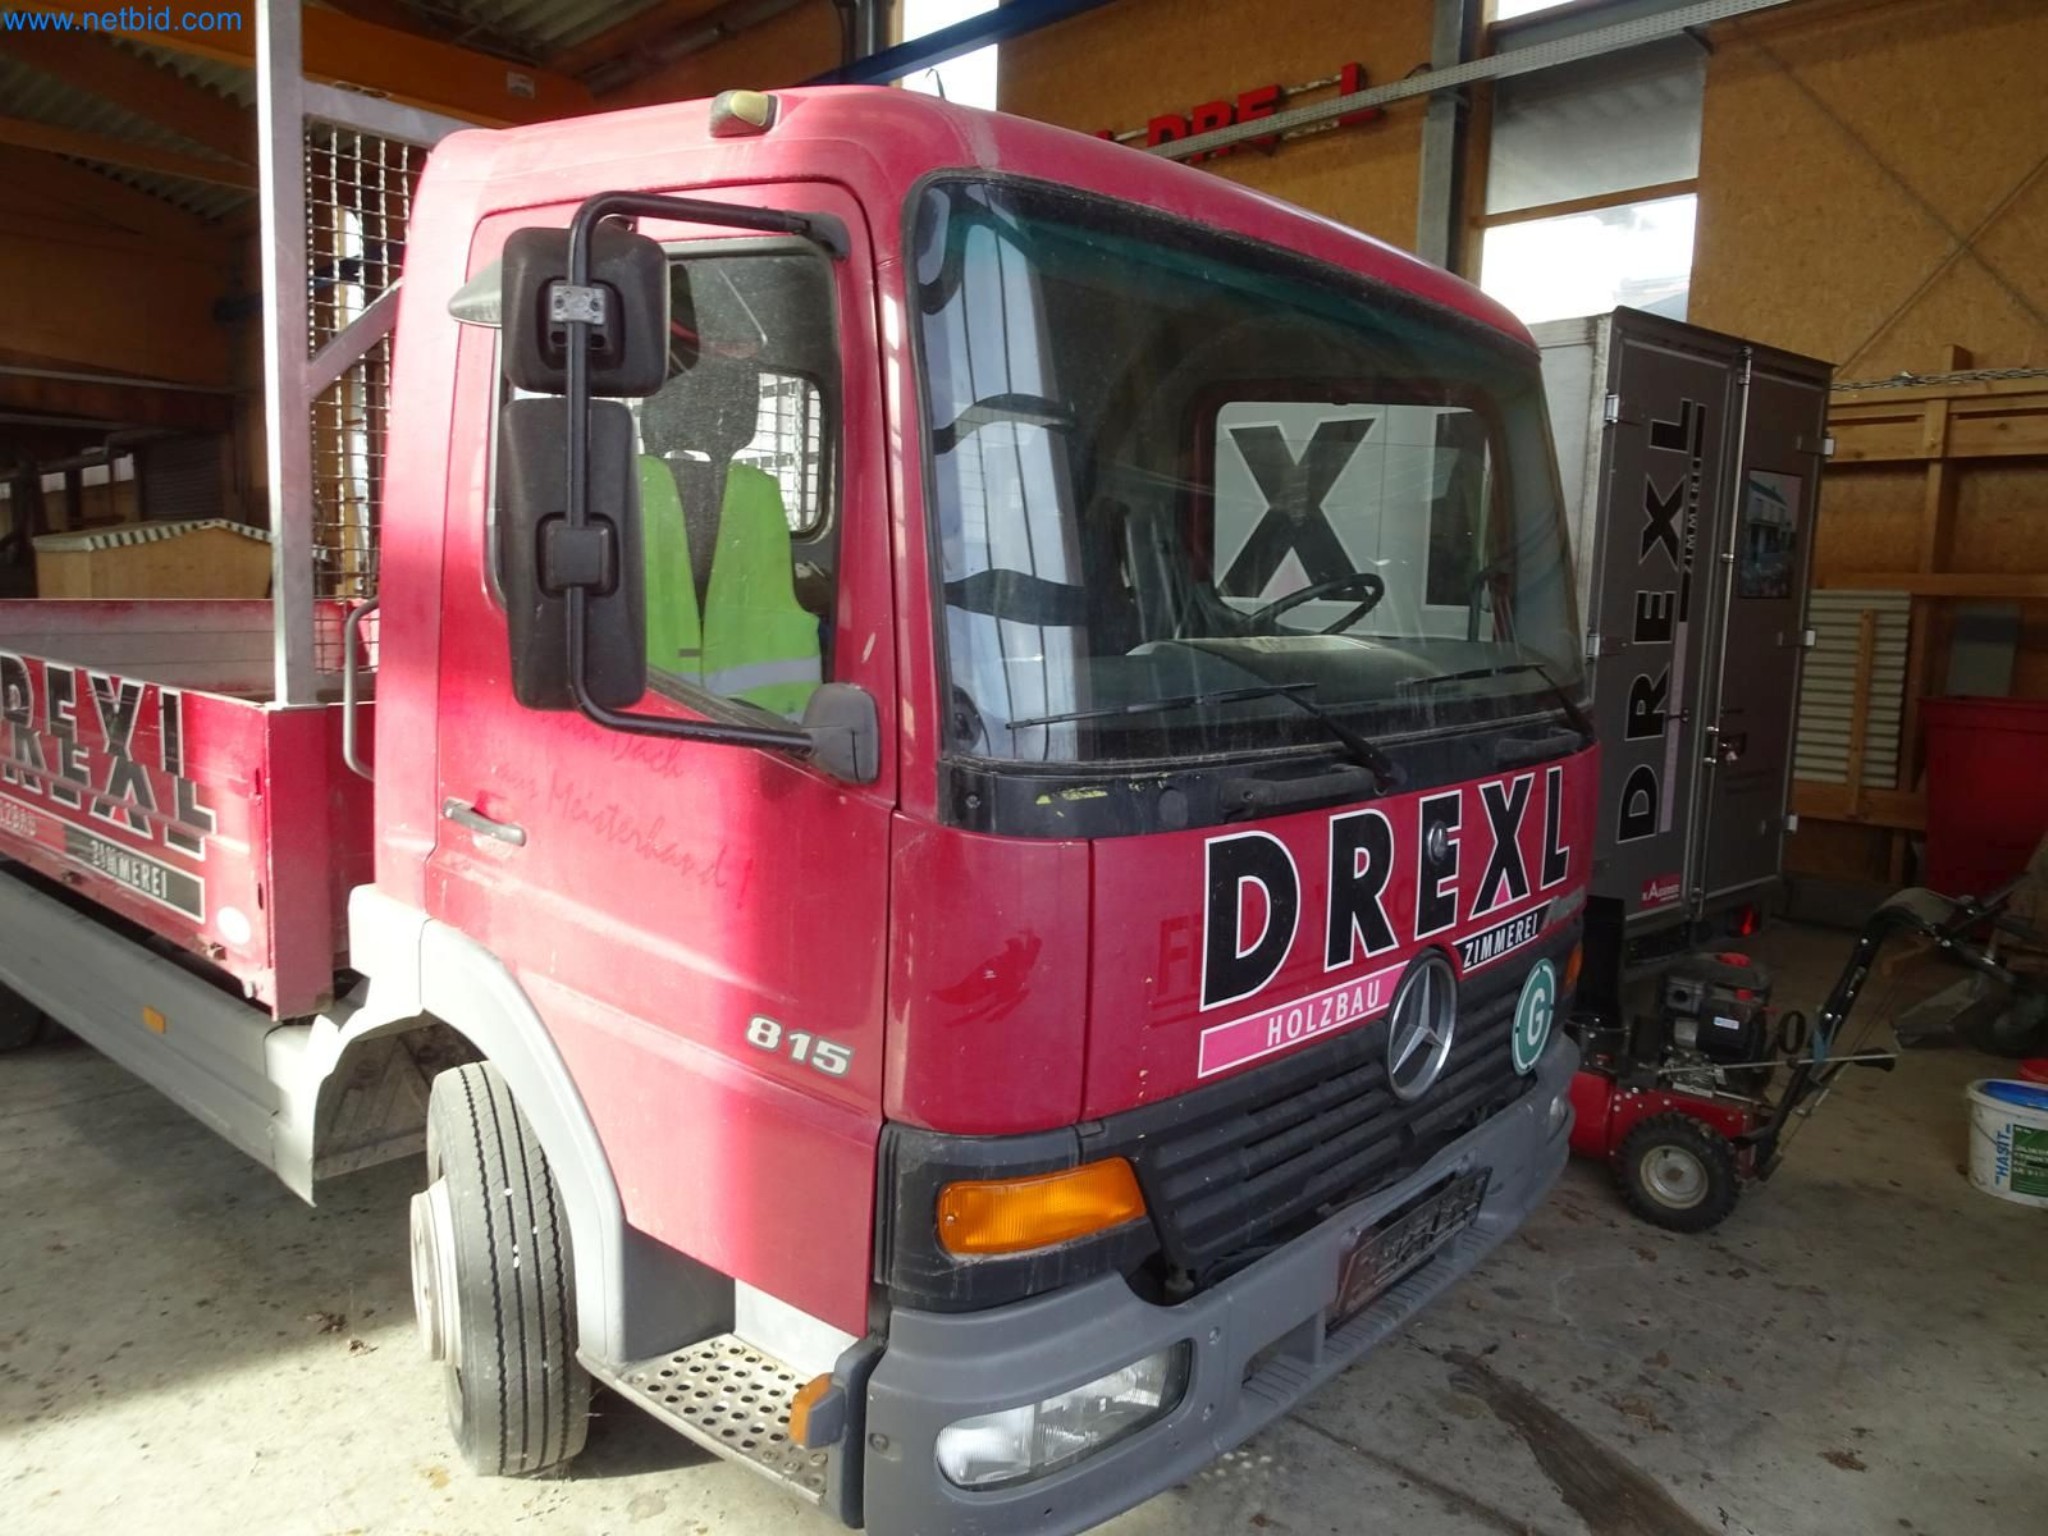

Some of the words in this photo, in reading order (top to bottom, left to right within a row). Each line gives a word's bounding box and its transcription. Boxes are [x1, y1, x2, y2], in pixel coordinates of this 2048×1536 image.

[1616, 397, 1692, 845] DREXL
[89, 839, 168, 899] ZIMMEREI
[1200, 765, 1571, 1012] DREXL
[1463, 912, 1538, 968] ZIMMEREI
[744, 1013, 855, 1077] 815
[1265, 979, 1381, 1048] HOLZBAU
[1526, 987, 1546, 1047] G
